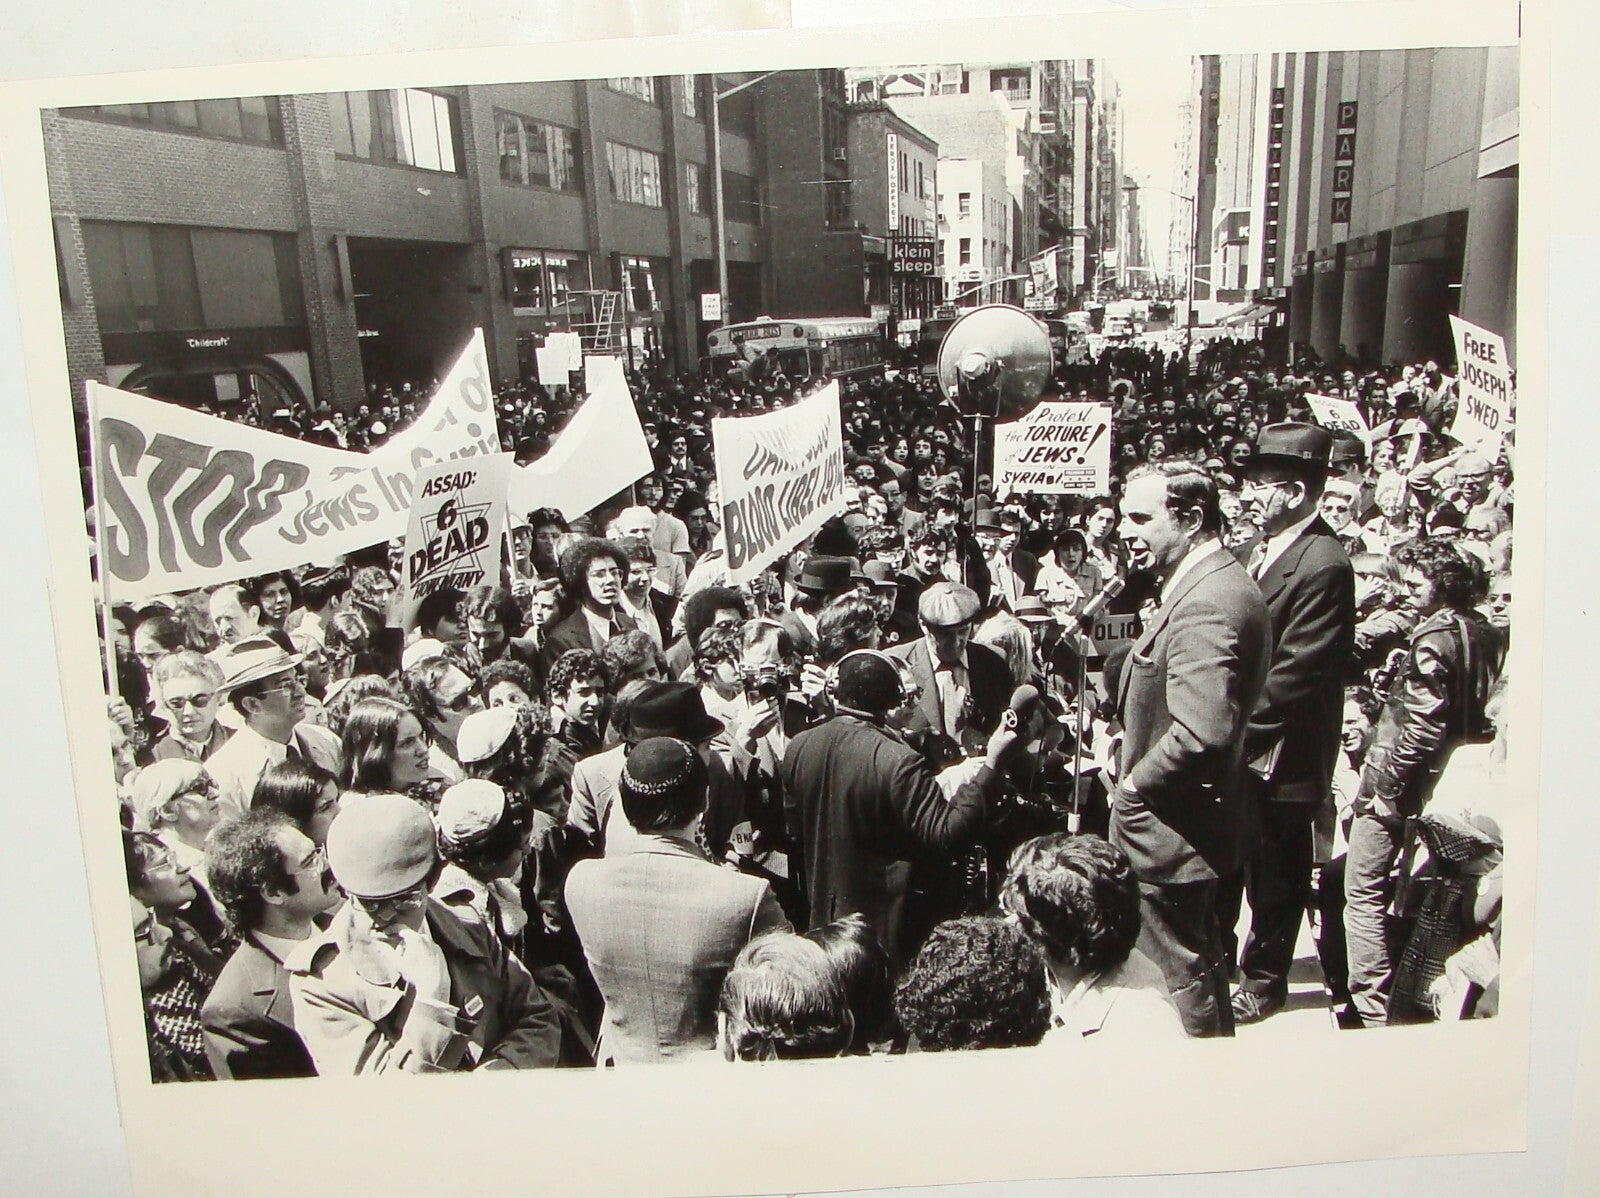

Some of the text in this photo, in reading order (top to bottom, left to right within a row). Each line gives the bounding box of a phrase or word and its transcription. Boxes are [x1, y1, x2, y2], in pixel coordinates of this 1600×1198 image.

[1335, 105, 1355, 219] PARK
[893, 257, 933, 274] sleep
[895, 244, 931, 258] klein
[1463, 331, 1497, 364] FREE
[1461, 359, 1507, 402] JOSEPH
[1035, 405, 1094, 424] Protest
[1323, 419, 1361, 431] DEAD
[1329, 409, 1341, 419] 6
[1466, 394, 1500, 431] SWED
[1024, 424, 1093, 443] TORTURE
[100, 417, 310, 582] STOP
[421, 470, 477, 499] ASSAD:
[278, 482, 380, 546] Jews
[371, 466, 414, 513] In
[437, 499, 457, 531] 6
[722, 483, 781, 570] BLOOD
[778, 465, 820, 533] LIBEL
[409, 516, 489, 584] DEAD
[413, 570, 486, 600] HOW MANY
